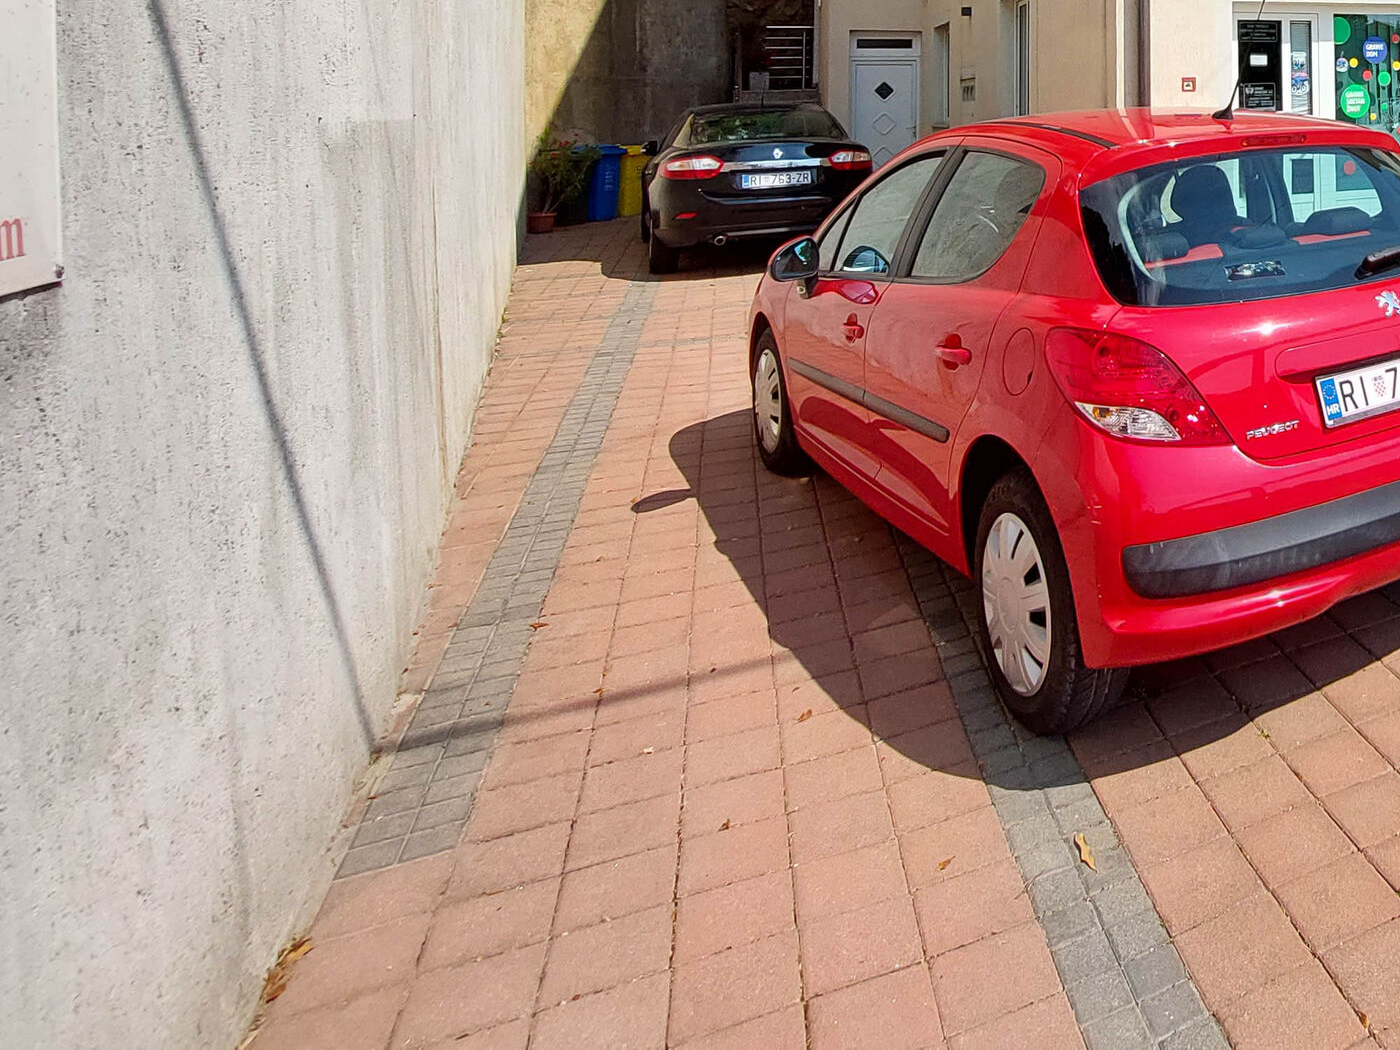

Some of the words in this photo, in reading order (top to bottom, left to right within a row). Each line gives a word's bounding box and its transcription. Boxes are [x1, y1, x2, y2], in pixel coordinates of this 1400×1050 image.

[750, 175, 762, 186] RI
[1338, 375, 1370, 413] RI
[1326, 403, 1341, 417] HR
[1246, 419, 1300, 440] PEUGEOT
